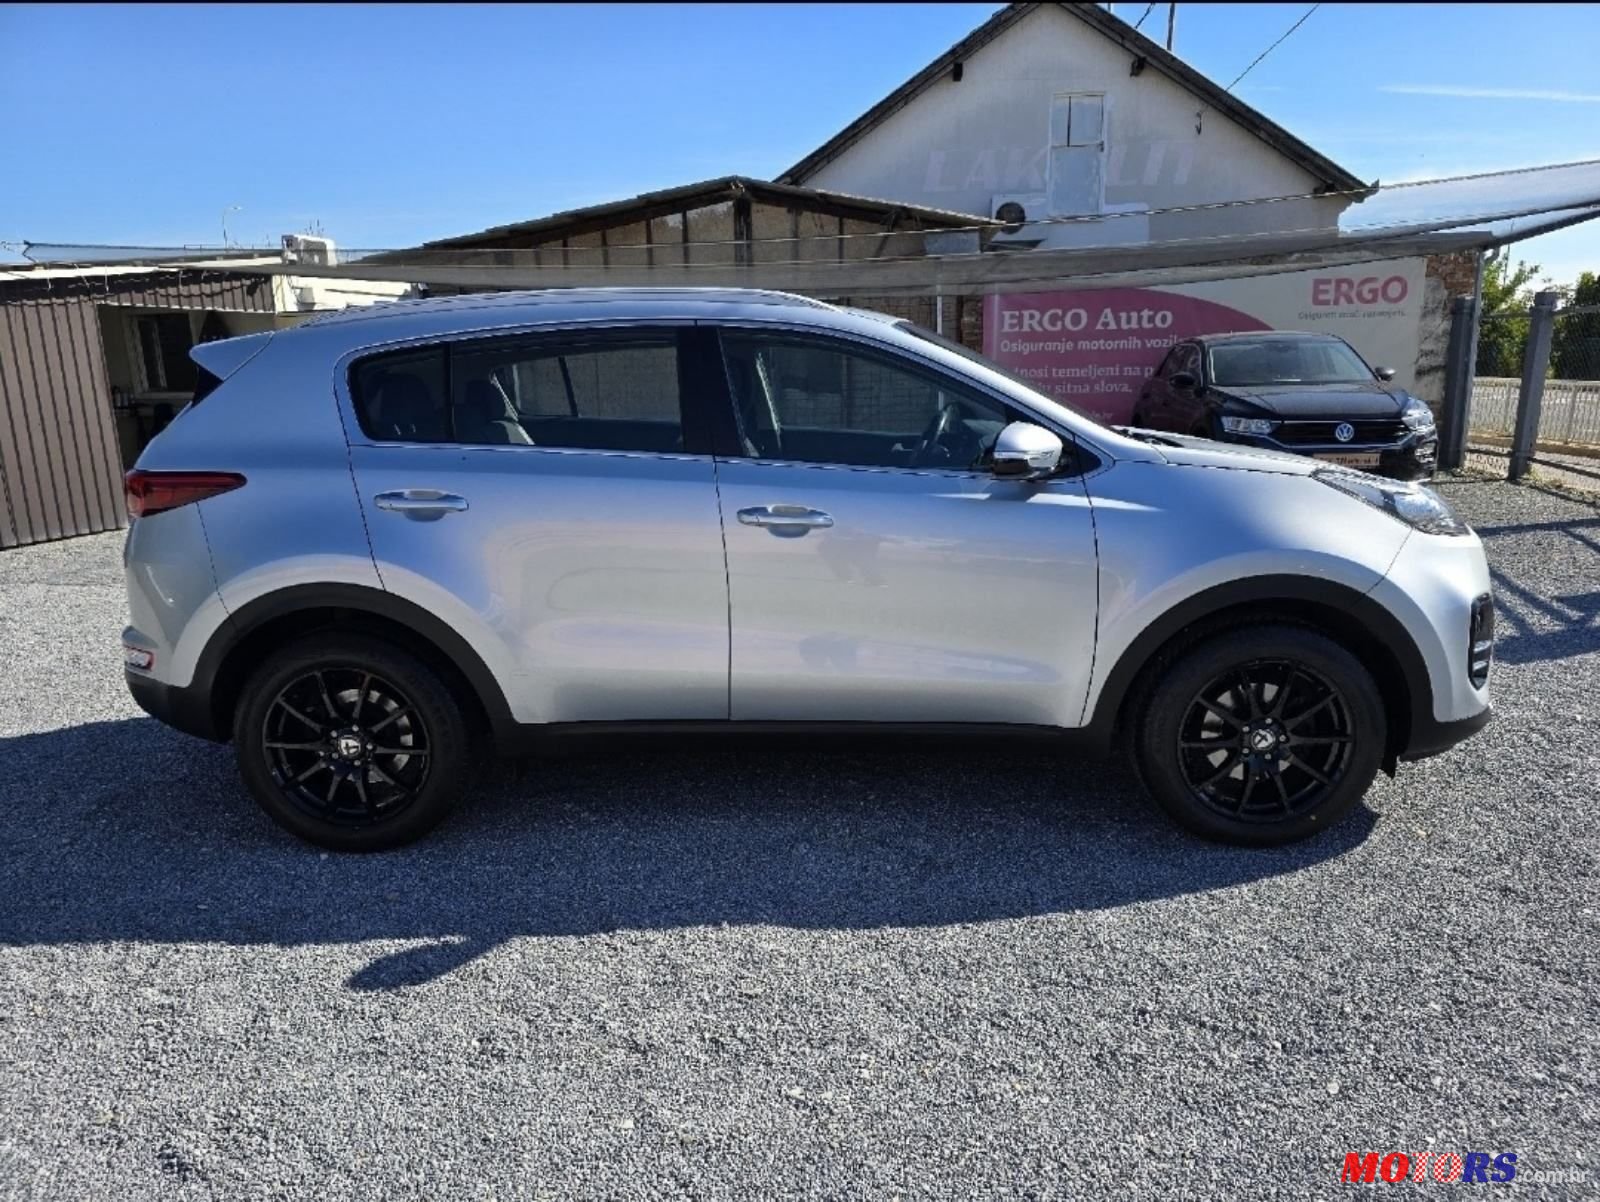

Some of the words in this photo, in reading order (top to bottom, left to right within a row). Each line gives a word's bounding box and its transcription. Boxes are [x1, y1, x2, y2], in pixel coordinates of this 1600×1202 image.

[1312, 276, 1408, 306] ERGO
[1001, 308, 1088, 332] ERGO
[1096, 307, 1173, 330] Auto
[1000, 338, 1073, 355] Osiguranje
[1077, 336, 1141, 350] motornih
[1014, 365, 1049, 378] nosi
[1052, 363, 1120, 381] temeljeni
[1122, 365, 1141, 377] na
[1055, 381, 1090, 394] sitna
[1094, 380, 1133, 392] slova.
